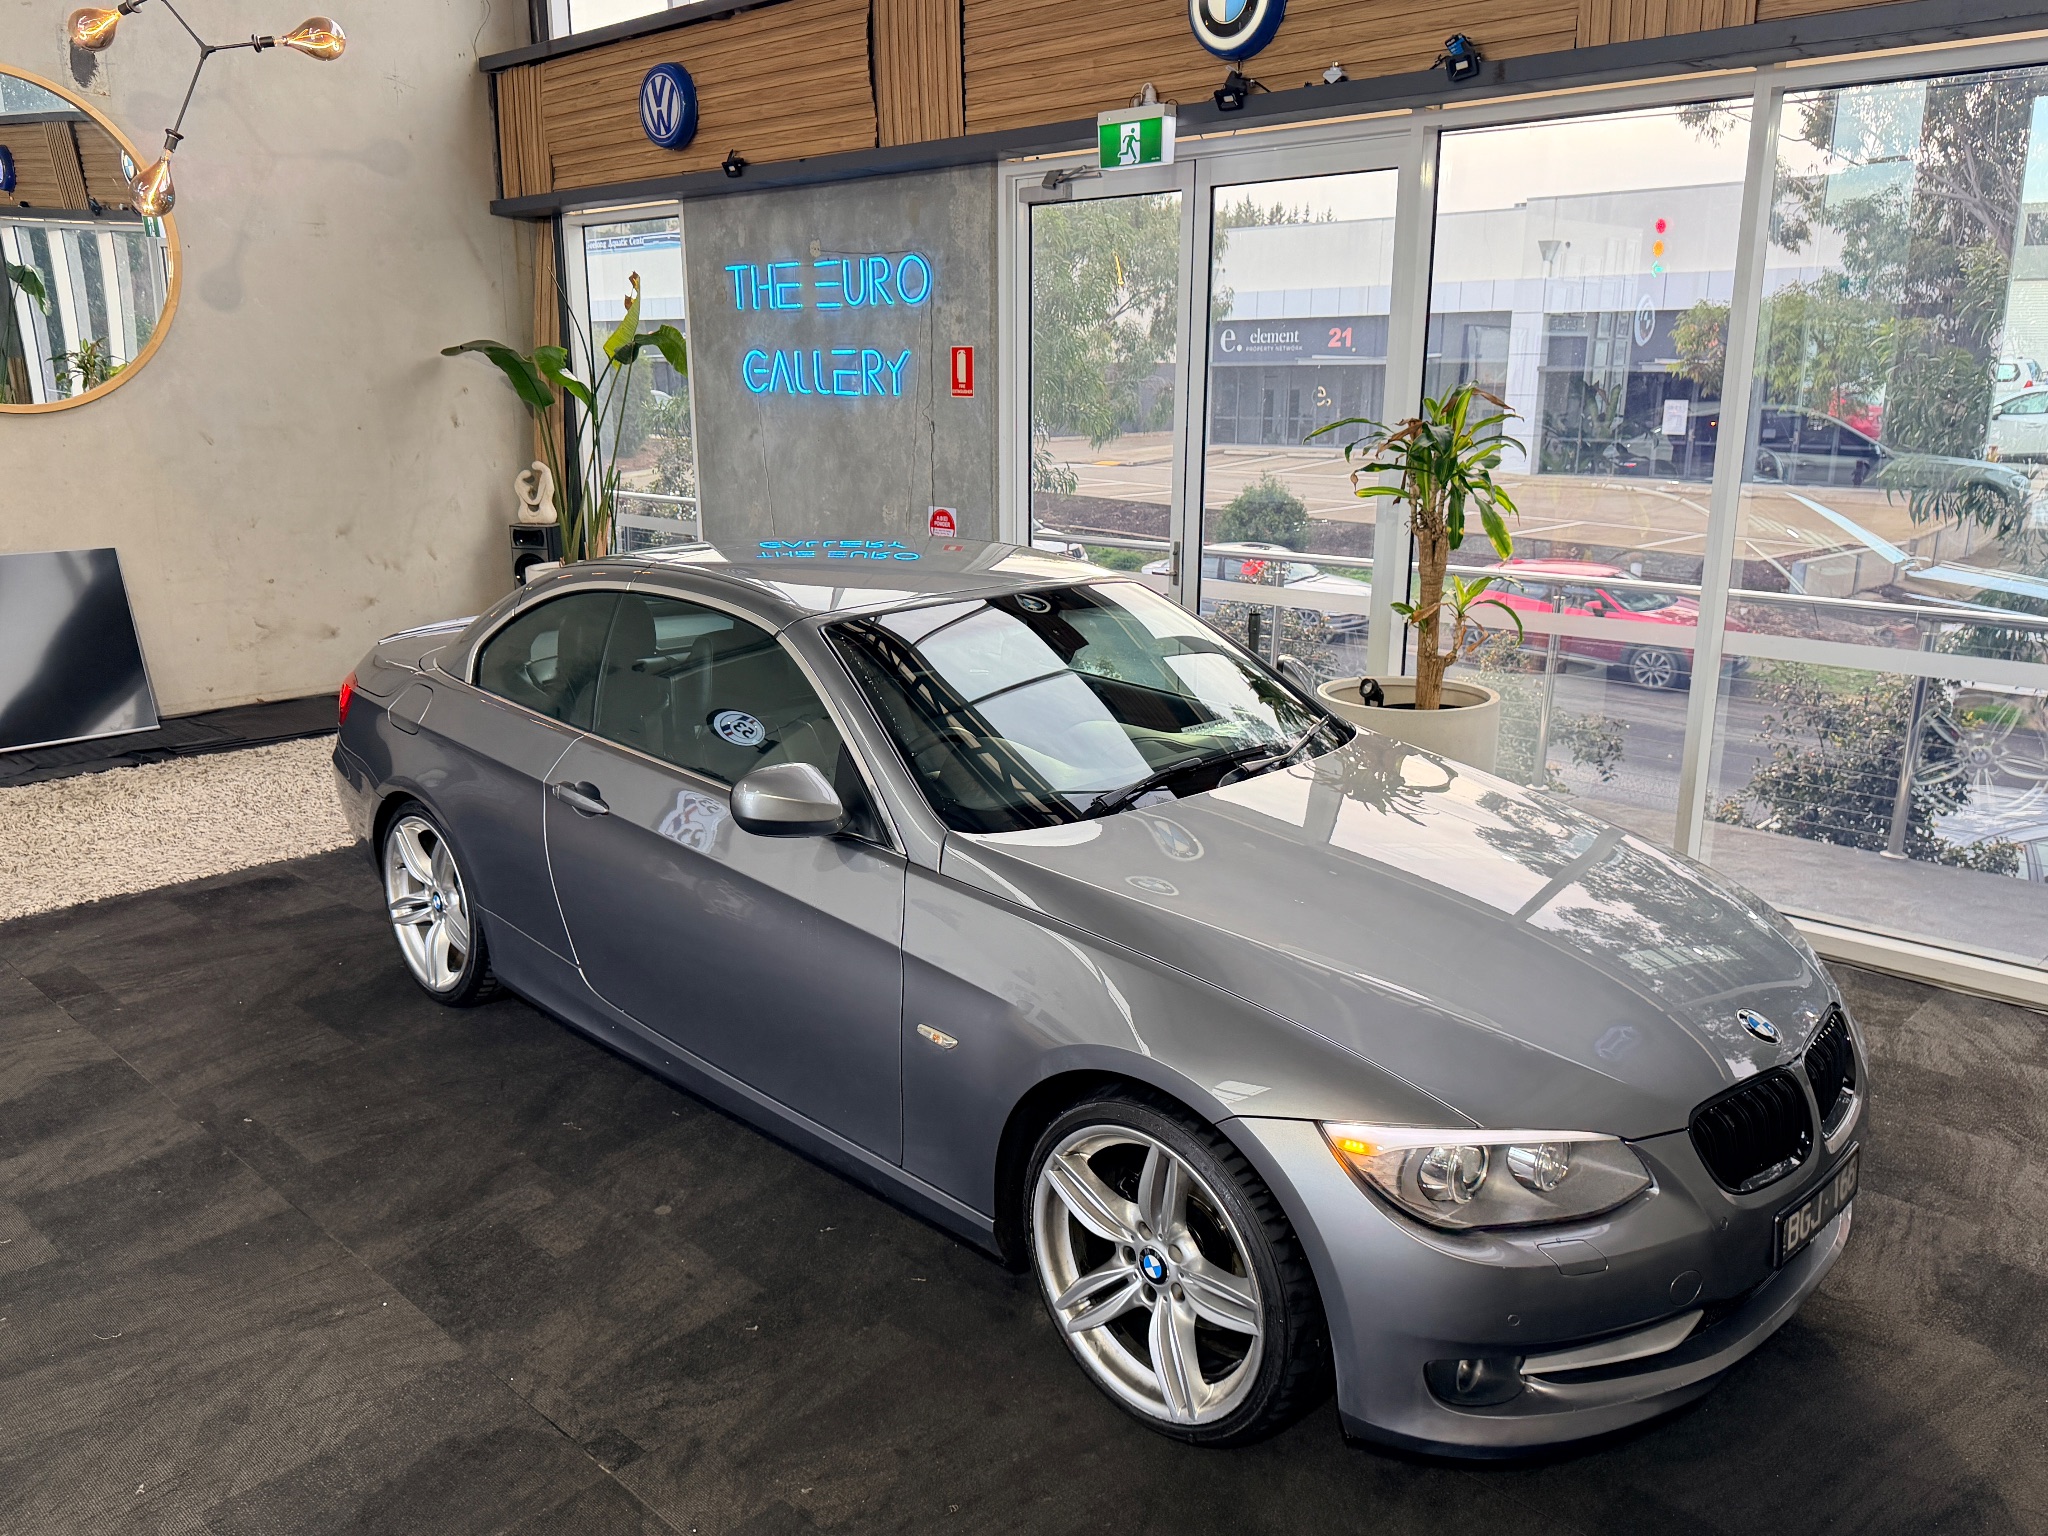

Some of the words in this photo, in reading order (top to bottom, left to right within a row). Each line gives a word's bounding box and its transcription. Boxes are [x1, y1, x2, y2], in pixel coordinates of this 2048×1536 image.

[725, 262, 803, 310] THE
[813, 253, 932, 309] EURO
[1249, 327, 1300, 344] element
[1327, 327, 1353, 348] 21
[742, 349, 911, 397] GALLERY
